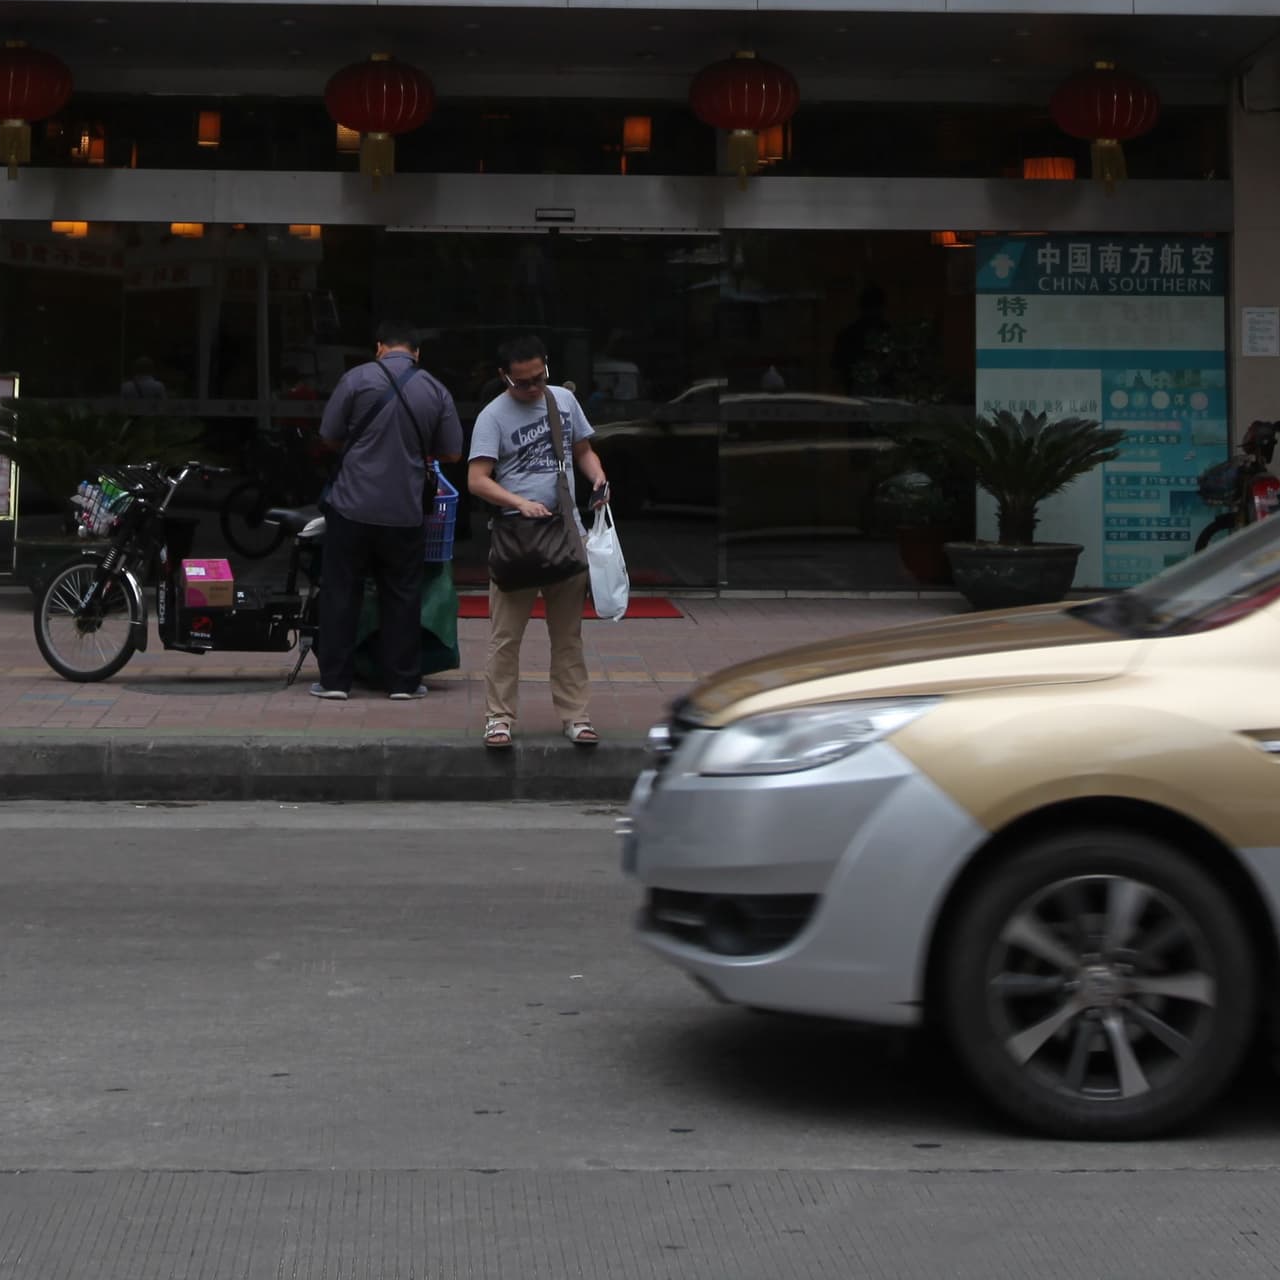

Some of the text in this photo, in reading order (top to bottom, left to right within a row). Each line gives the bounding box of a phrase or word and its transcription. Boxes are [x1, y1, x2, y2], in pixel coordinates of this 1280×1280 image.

[1037, 241, 1216, 275] 中国南方航空
[1038, 277, 1212, 293] CHINA SOUTHERN
[997, 295, 1028, 344] 特价
